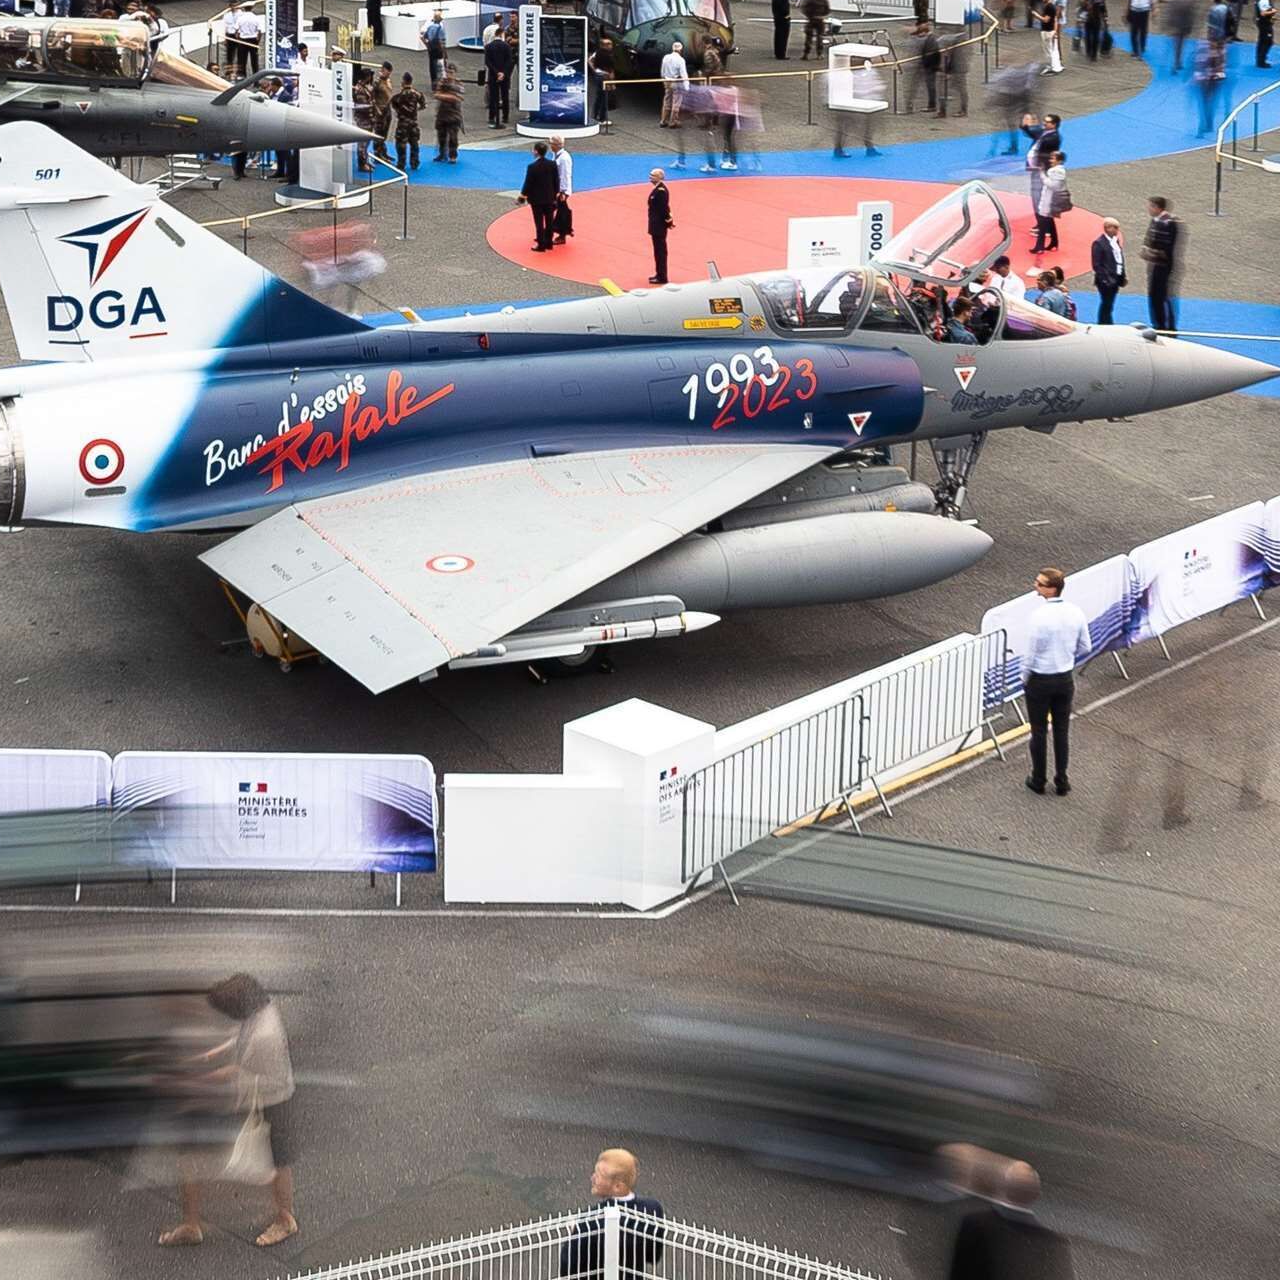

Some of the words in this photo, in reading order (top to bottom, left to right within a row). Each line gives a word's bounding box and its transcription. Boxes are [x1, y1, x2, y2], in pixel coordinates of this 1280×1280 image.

[526, 12, 535, 45] TERRE
[526, 48, 535, 92] CAIMAN
[34, 167, 61, 182] 501
[48, 287, 166, 332] DGA
[681, 345, 780, 420] 1993
[712, 358, 818, 430] 2023
[204, 431, 268, 486] Banc
[276, 371, 368, 440] d'essais
[245, 369, 456, 495] Rafale
[238, 794, 298, 807] MINISTÈRE
[238, 807, 260, 817] DES
[262, 806, 308, 818] ARMÉES
